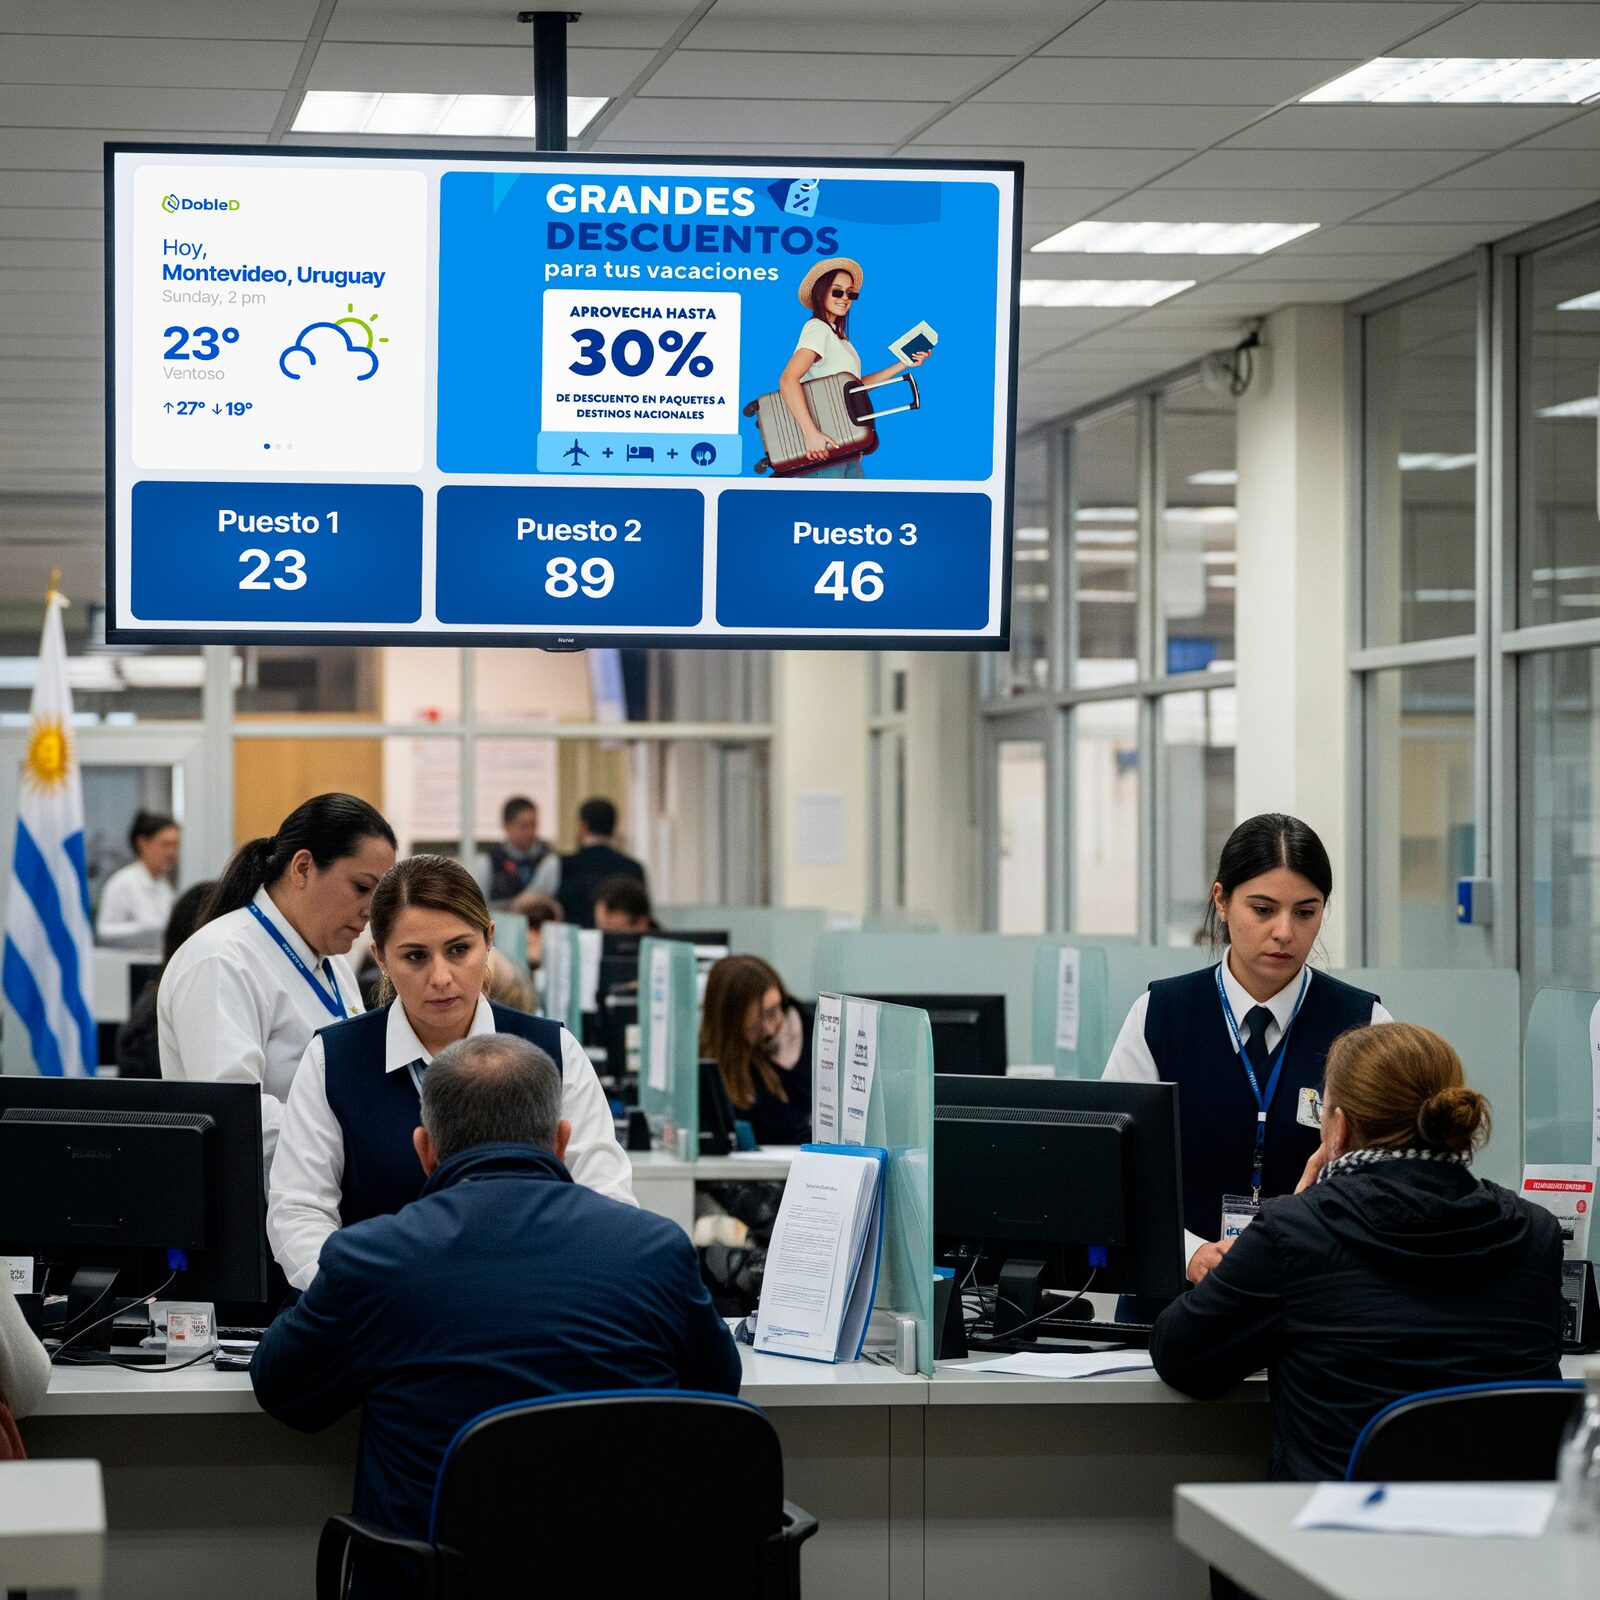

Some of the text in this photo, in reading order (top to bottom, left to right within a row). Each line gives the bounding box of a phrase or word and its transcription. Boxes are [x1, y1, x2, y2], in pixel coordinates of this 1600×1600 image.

[181, 198, 241, 211] DobleD
[545, 183, 756, 217] GRANDES
[163, 238, 207, 261] Hoy,
[546, 221, 840, 256] DESCUENTOS
[162, 263, 386, 289] Montevideo, Uruguay
[544, 261, 779, 282] para tus vacaciones
[162, 289, 266, 307] Sunday, 2 pm
[569, 305, 717, 320] APROVECHA HASTA
[568, 328, 714, 379] 30%
[162, 366, 225, 381] Ventoso
[556, 393, 726, 407] DE DESCUENTO EN PAQUETES A
[576, 408, 705, 420] DESTINOS NACIONALES
[218, 509, 338, 534] Puesto 1
[517, 517, 642, 542] Puesto 2
[793, 521, 918, 546] Puesto 3
[238, 548, 308, 591] 23
[544, 556, 615, 599] 89
[813, 560, 885, 602] 46
